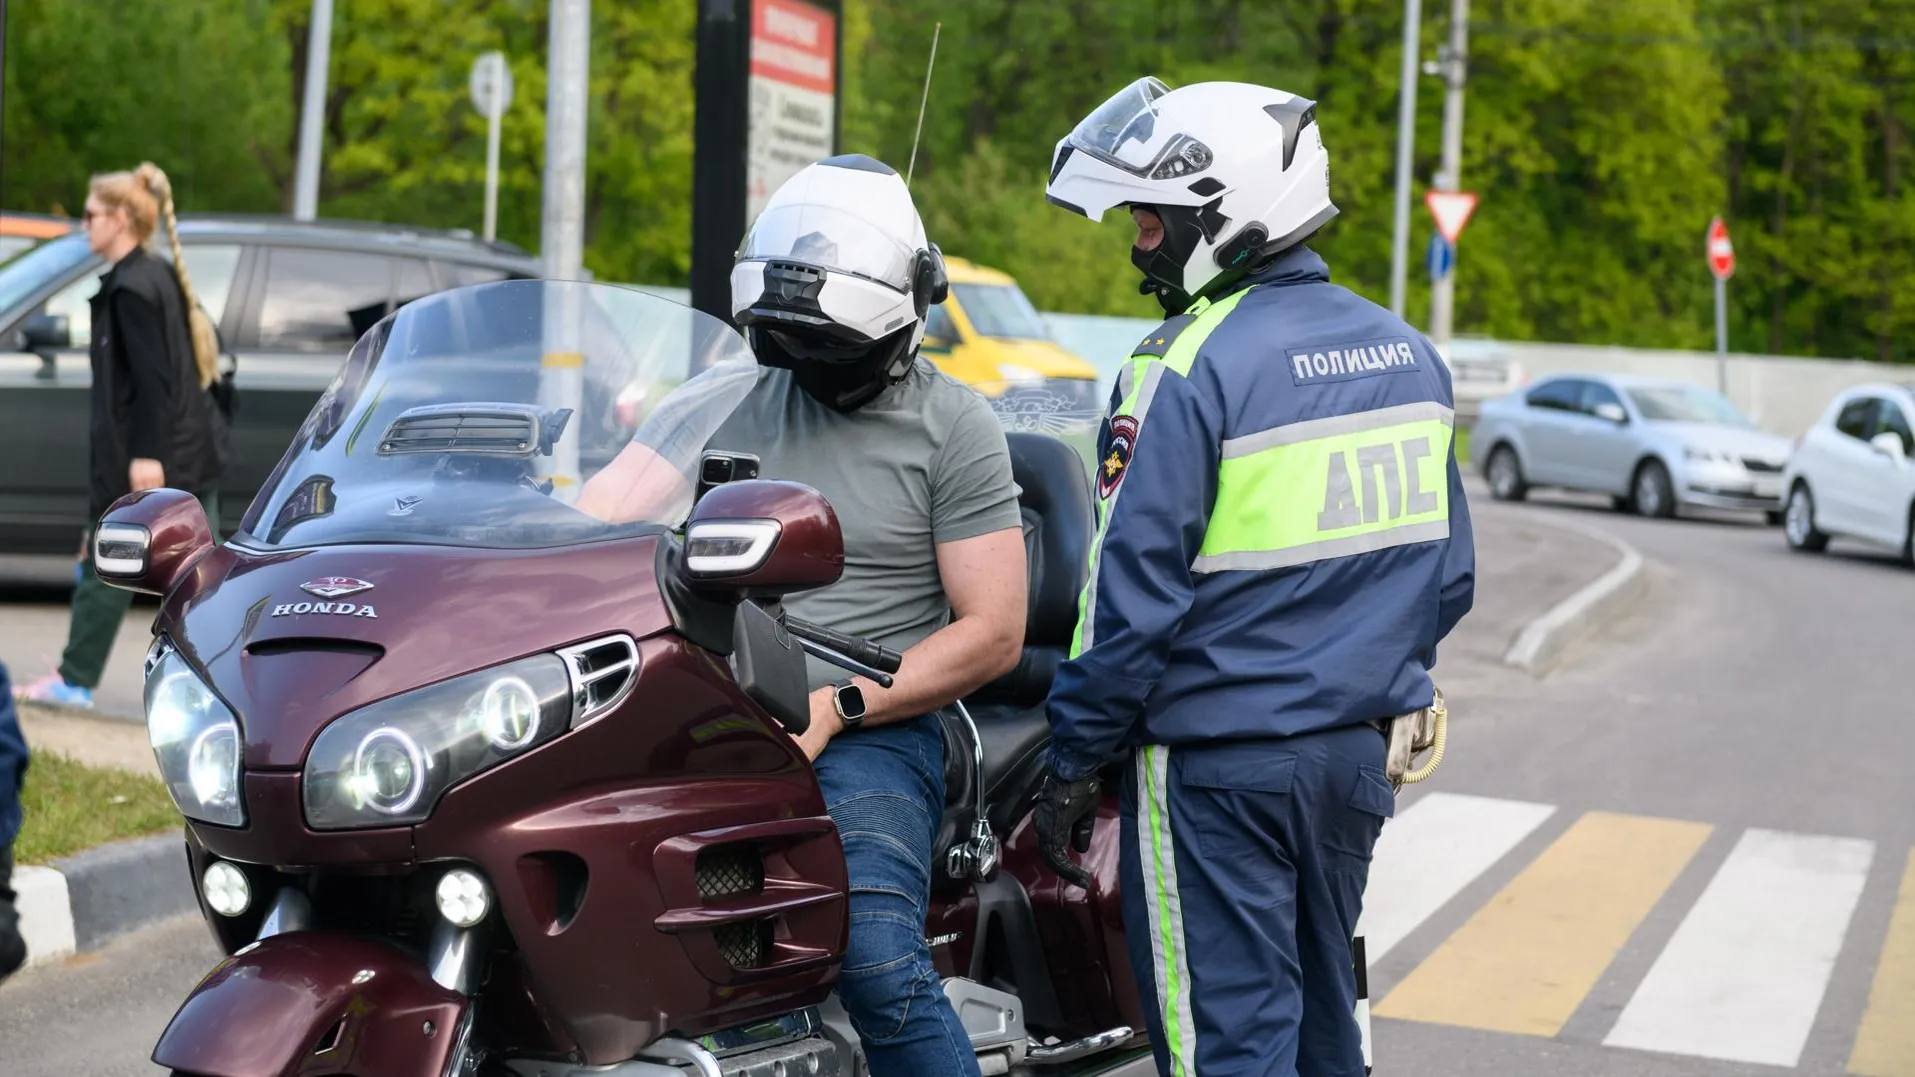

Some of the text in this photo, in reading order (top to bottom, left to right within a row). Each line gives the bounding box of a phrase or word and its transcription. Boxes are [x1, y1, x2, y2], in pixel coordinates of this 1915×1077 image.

[1293, 343, 1415, 379] ПОЛИЦИЯ
[1317, 437, 1437, 531] ДПС
[271, 602, 378, 618] HONDA
